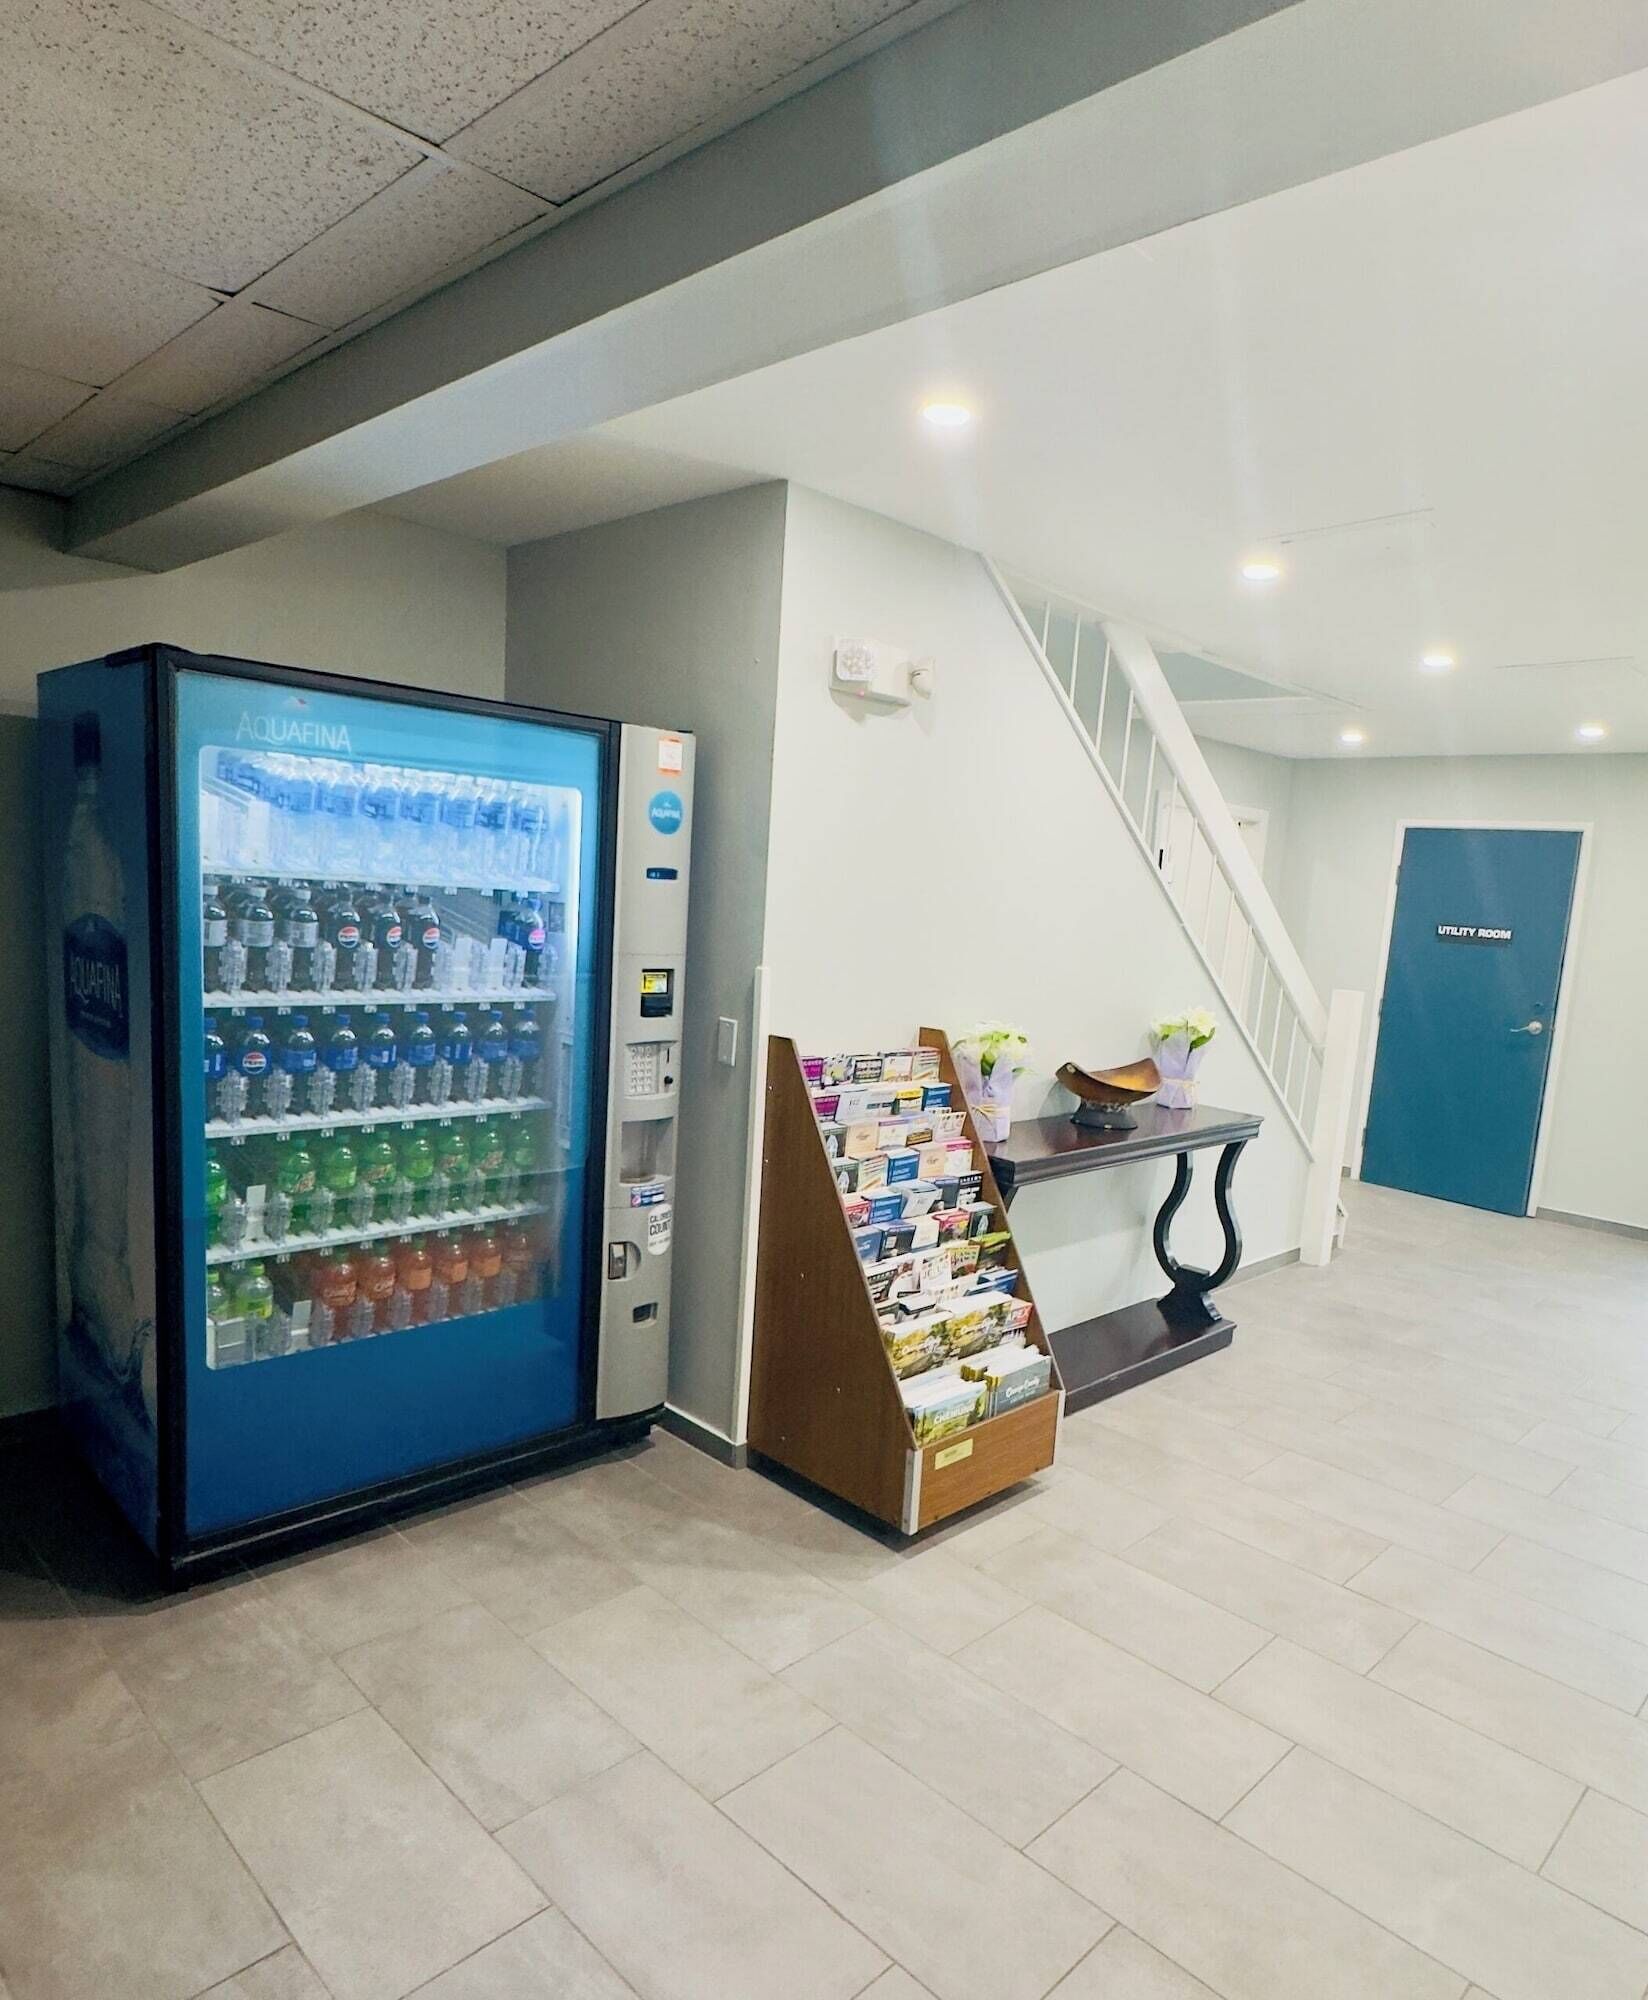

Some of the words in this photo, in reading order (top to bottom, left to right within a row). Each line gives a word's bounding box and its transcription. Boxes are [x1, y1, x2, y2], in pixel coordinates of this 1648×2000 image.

[235, 711, 352, 755] AQUAFINA
[1438, 925, 1476, 937] UTILITY
[1477, 928, 1512, 940] ROOM
[70, 953, 122, 1018] AQUAFINA
